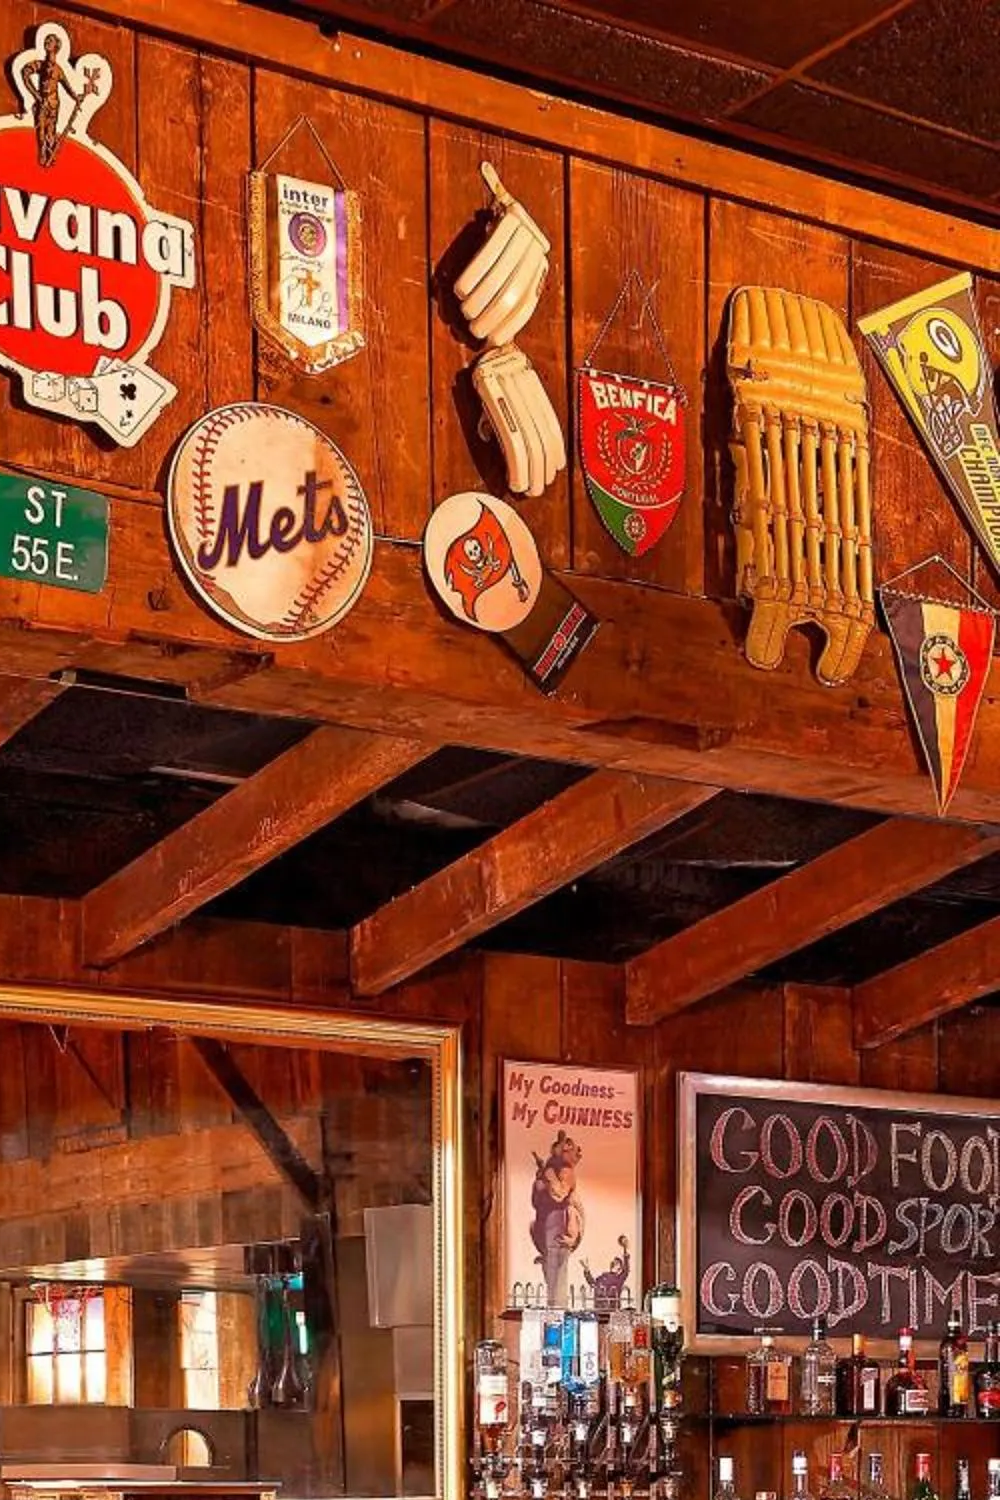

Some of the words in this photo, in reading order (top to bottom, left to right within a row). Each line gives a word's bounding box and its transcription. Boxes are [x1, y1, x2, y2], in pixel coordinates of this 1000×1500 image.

[288, 313, 331, 329] MILANO
[589, 379, 677, 426] BENFICA
[24, 486, 68, 529] ST
[197, 470, 349, 570] Mets
[11, 535, 49, 576] 55
[509, 1072, 534, 1095] My
[512, 1102, 539, 1129] My
[710, 1107, 879, 1188] GOOD
[890, 1121, 1000, 1213] FOO
[730, 1185, 887, 1253] GOOD
[701, 1254, 869, 1328] GOOD
